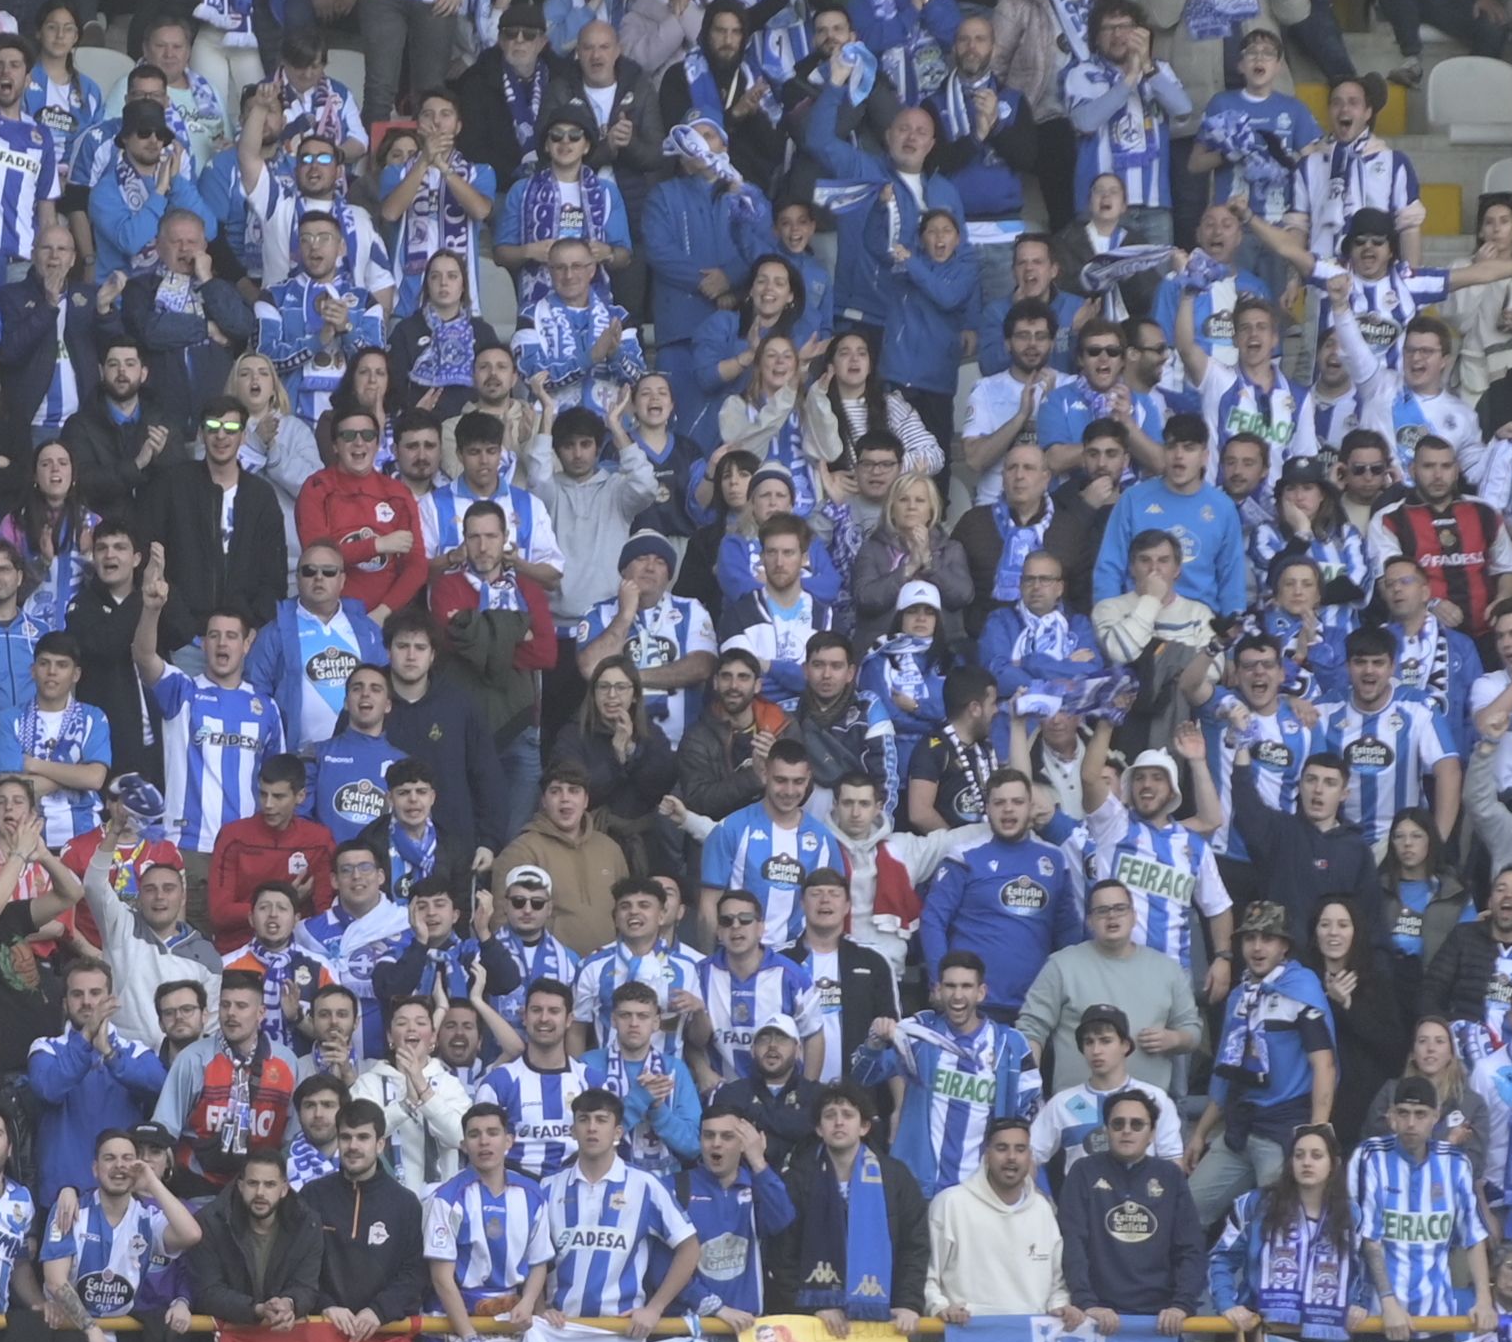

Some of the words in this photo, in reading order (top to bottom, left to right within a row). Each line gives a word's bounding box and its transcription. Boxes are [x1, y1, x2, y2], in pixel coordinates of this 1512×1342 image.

[341, 801, 381, 816] Galicia
[343, 792, 384, 809] Estrella
[1006, 887, 1043, 900] Estrella
[1007, 898, 1042, 907] Galicia
[935, 1068, 996, 1103] EIRACO
[1112, 1213, 1149, 1223] Estrella
[1112, 1222, 1148, 1232] Galicia
[1384, 1213, 1453, 1243] EIRACO
[85, 1277, 127, 1294] Estrella
[86, 1287, 124, 1304] Galicia
